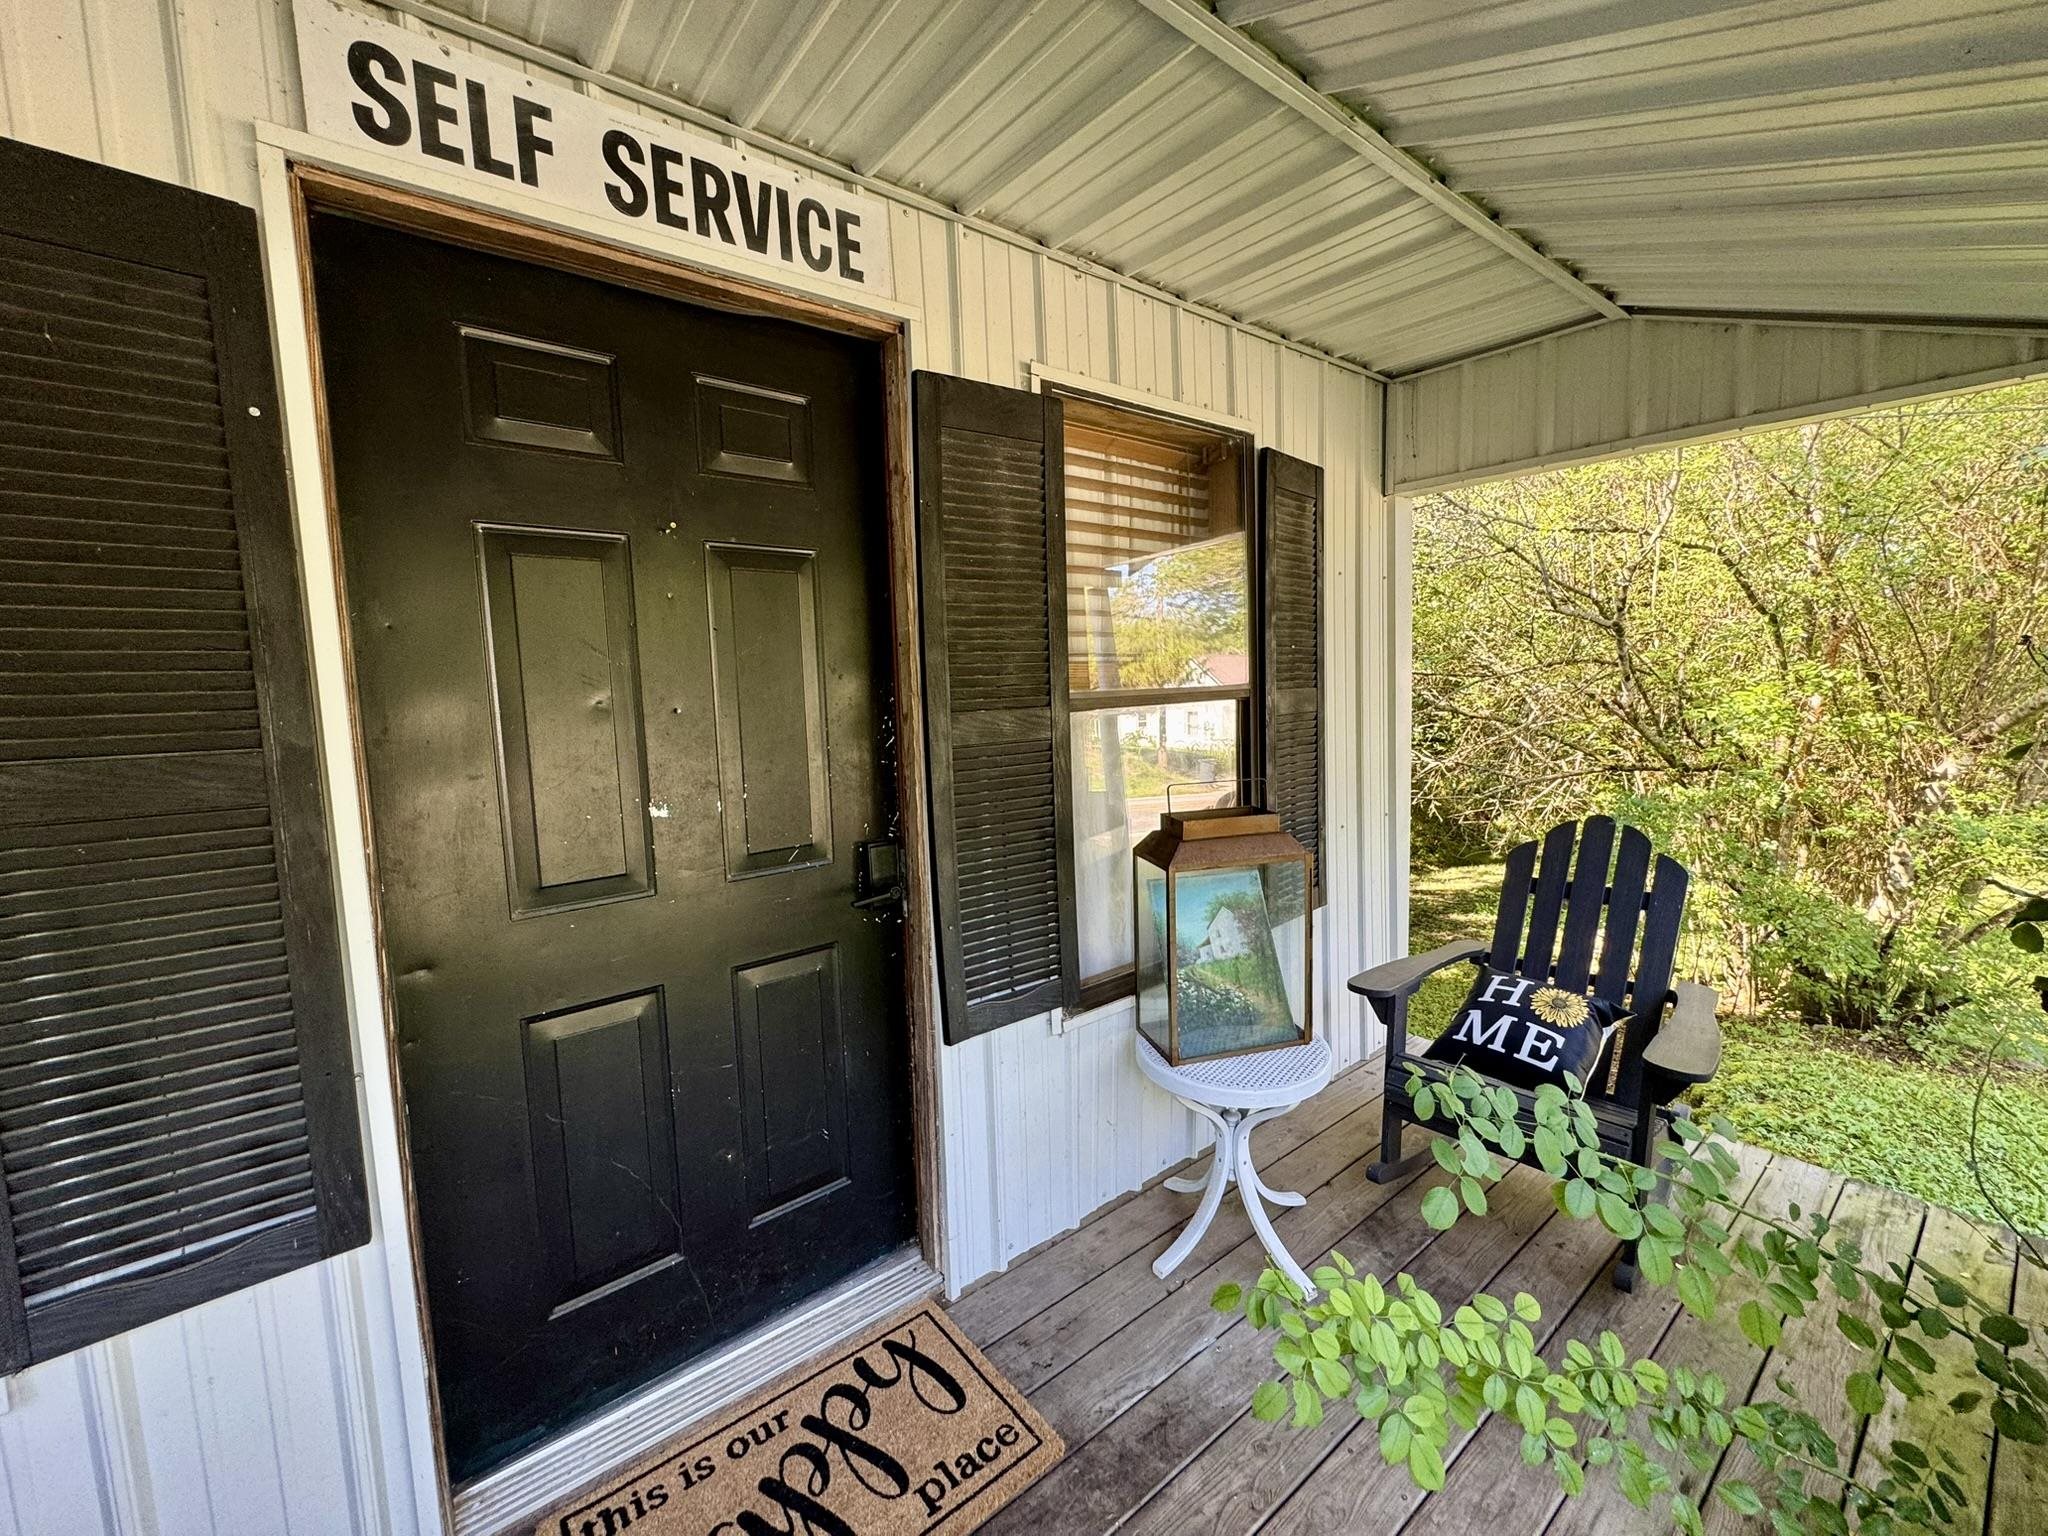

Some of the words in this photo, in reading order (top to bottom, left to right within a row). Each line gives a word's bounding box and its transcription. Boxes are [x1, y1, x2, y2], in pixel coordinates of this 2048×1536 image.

[347, 40, 554, 188] SELF
[602, 129, 865, 284] SERVICE
[1452, 1009, 1566, 1072] ME
[678, 1455, 716, 1490] is
[726, 1409, 789, 1460] our
[913, 1423, 1020, 1518] place
